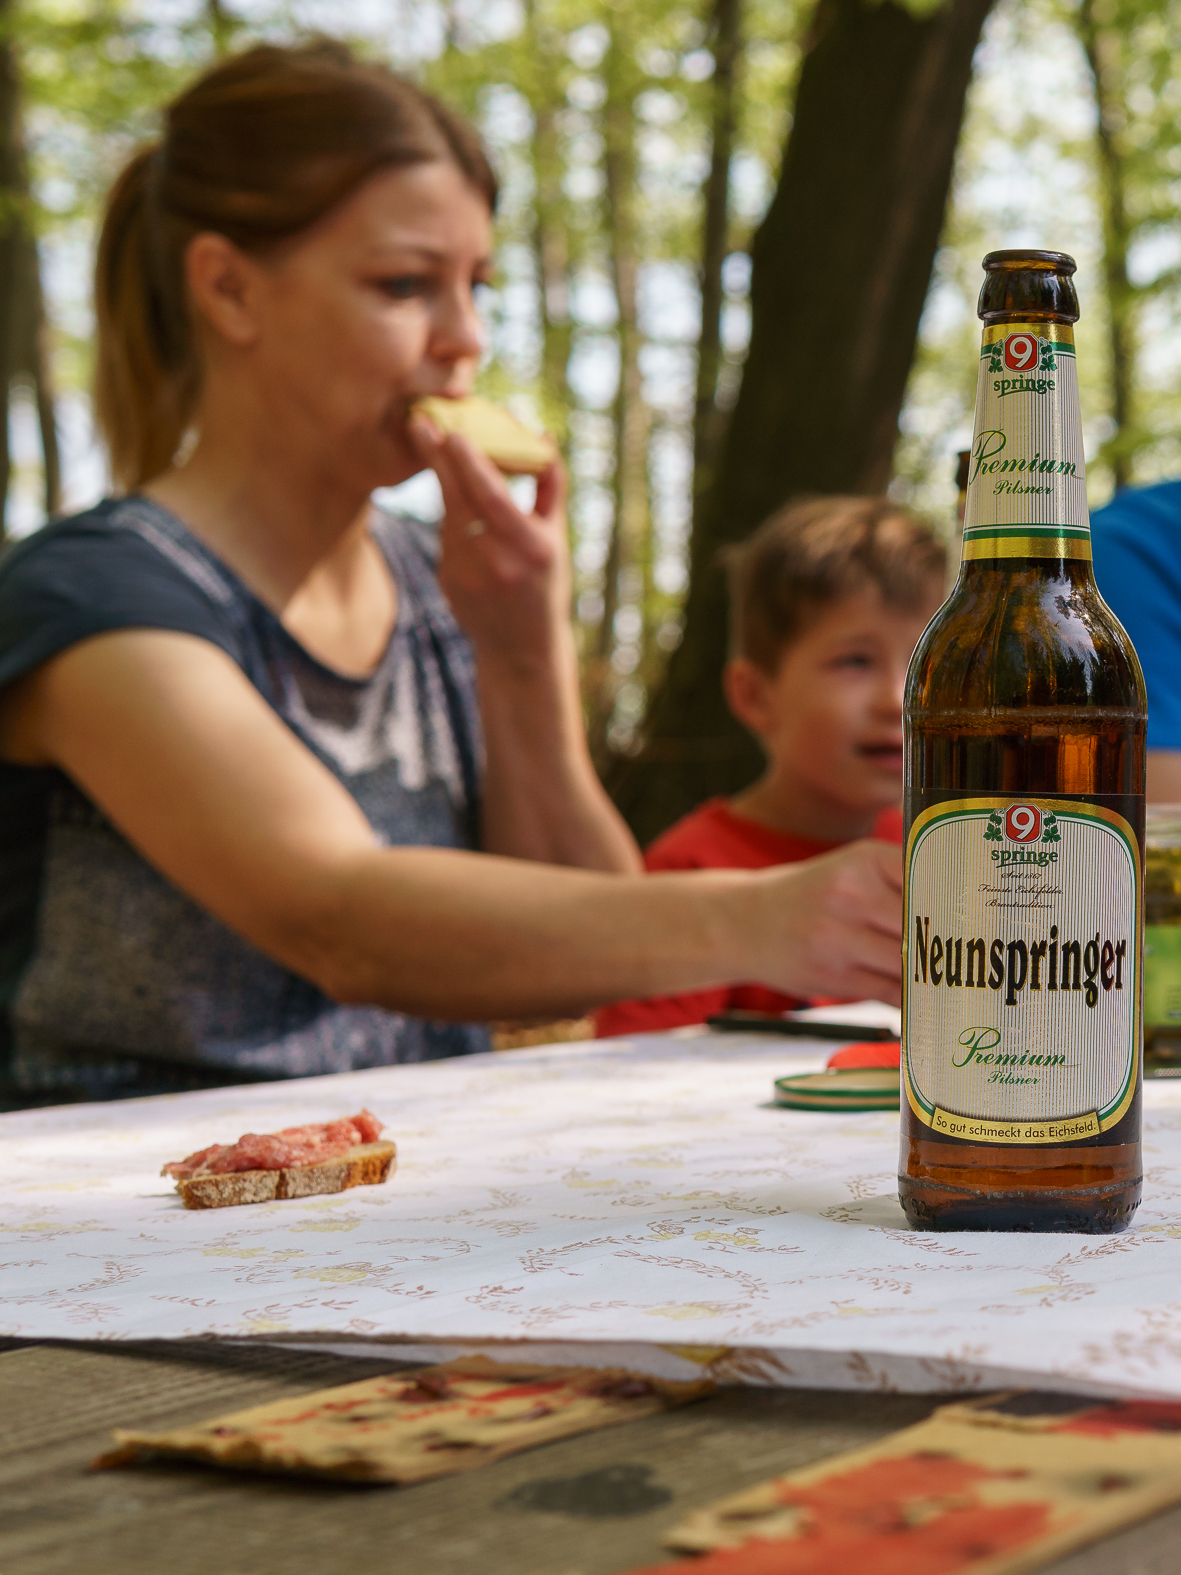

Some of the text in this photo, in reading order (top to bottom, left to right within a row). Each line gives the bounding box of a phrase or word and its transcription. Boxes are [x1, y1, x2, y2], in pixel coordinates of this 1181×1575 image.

[1009, 336, 1033, 368] 9
[993, 374, 1056, 398] springe
[968, 428, 1085, 486] Premium
[993, 480, 1054, 496] Pilsner
[1011, 806, 1036, 840] 9
[991, 847, 1059, 868] springe
[914, 915, 1127, 1009] Neunspringer
[952, 1026, 1081, 1068] Premium
[987, 1070, 1041, 1086] Pilsner
[936, 1115, 1097, 1138] So gut schmeckt das Eichsfeld.
